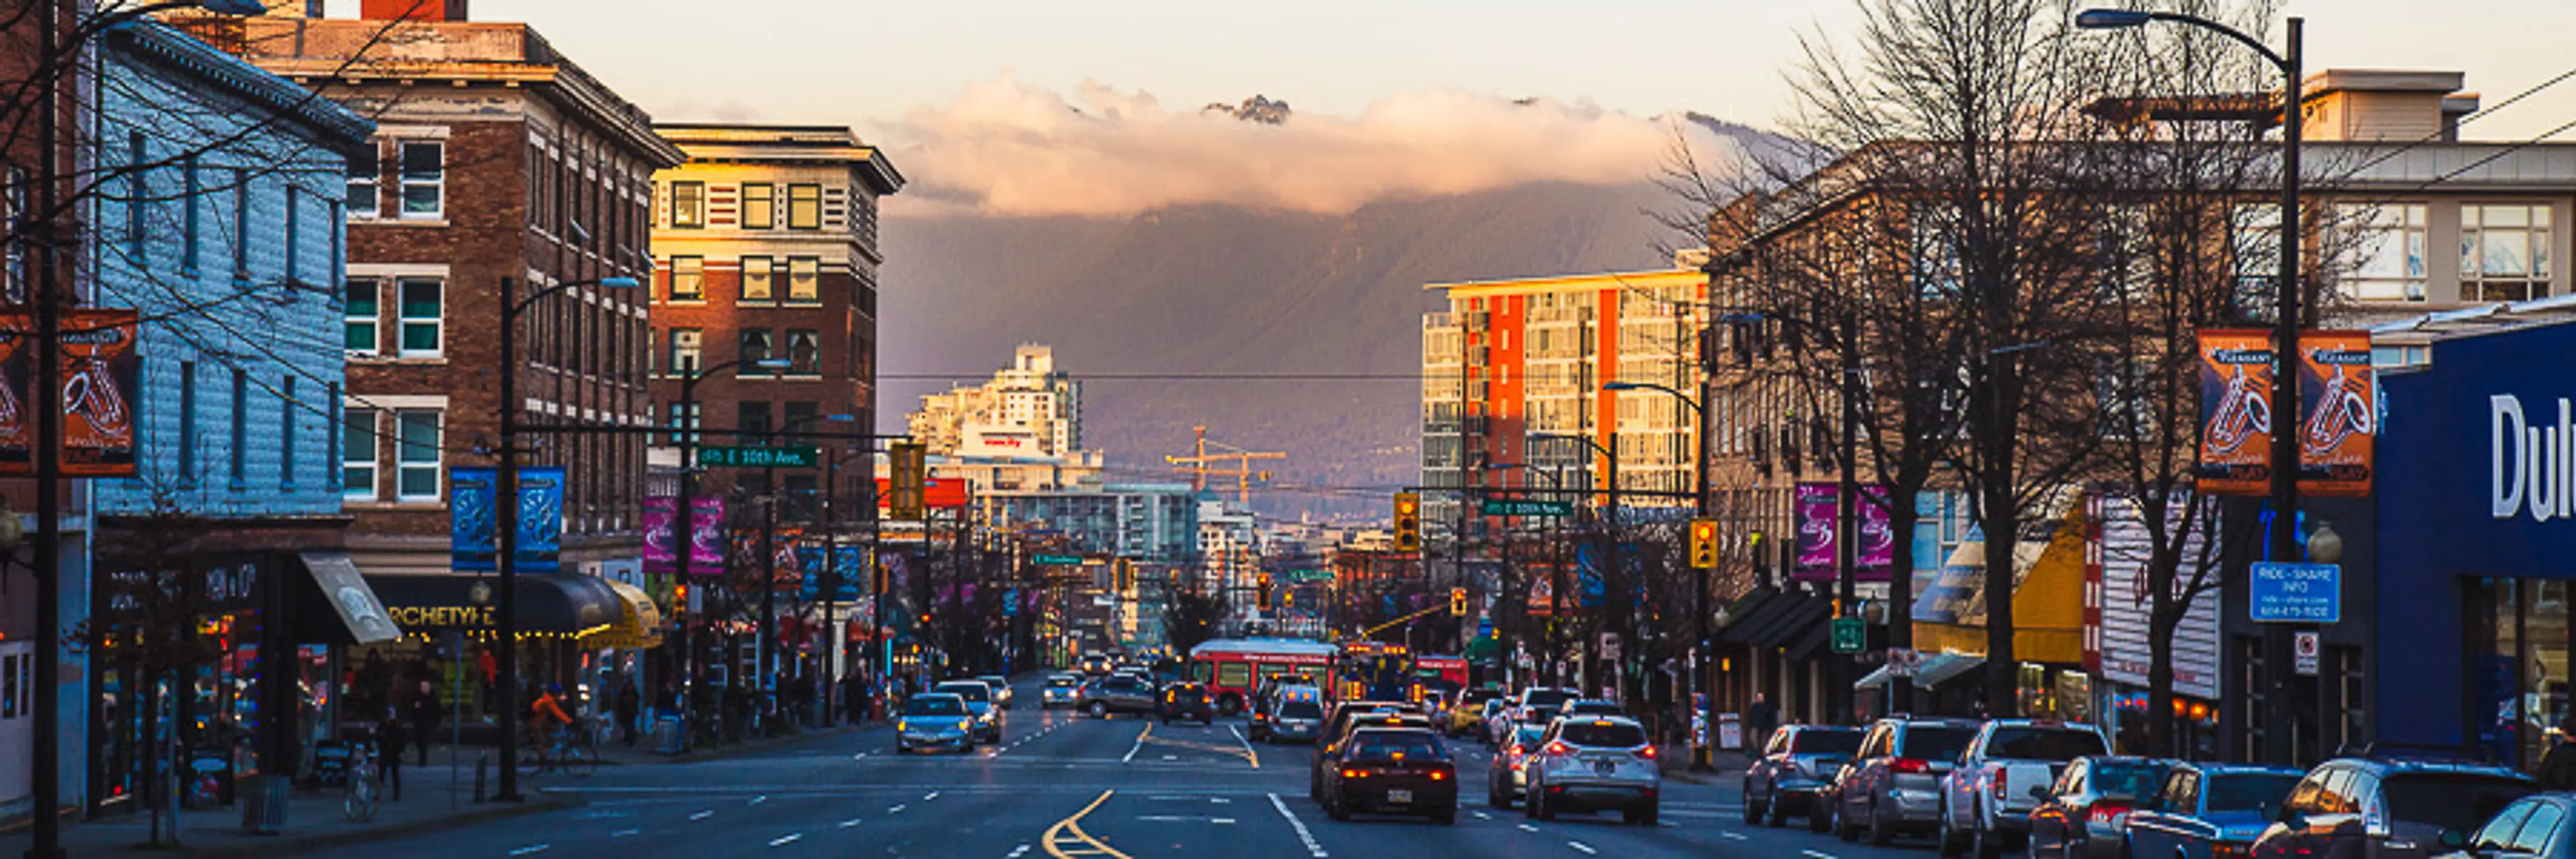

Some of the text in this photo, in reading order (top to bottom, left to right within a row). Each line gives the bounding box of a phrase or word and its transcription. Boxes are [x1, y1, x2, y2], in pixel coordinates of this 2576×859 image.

[743, 449, 773, 464] 10th
[775, 449, 804, 464] Ave.
[2489, 393, 2576, 522] Dul
[388, 606, 496, 625] RCHETYPE
